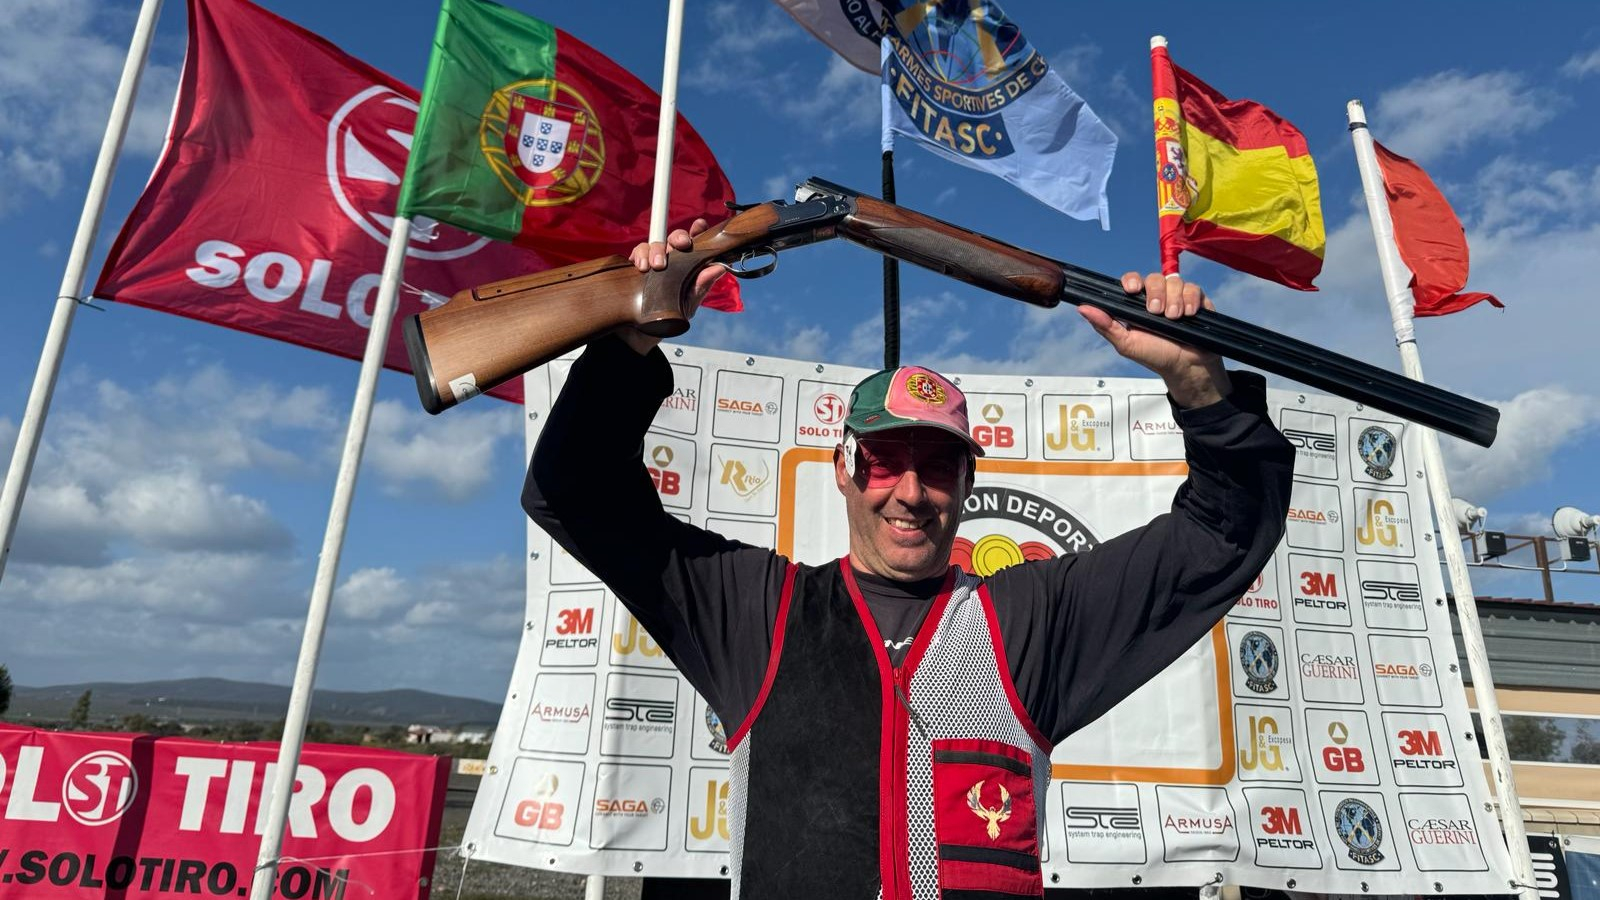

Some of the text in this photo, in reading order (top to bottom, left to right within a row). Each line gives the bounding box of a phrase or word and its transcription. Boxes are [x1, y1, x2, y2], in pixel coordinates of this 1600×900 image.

[890, 37, 932, 92] ARMES
[934, 85, 1005, 112] SPORTIVES
[1005, 72, 1031, 97] DE
[896, 73, 997, 155] FITASC
[186, 241, 399, 329] SOLO
[672, 388, 696, 399] AR
[662, 397, 696, 411] RINI
[717, 398, 763, 413] SAGA
[799, 426, 842, 438] SOLO TI
[1132, 420, 1177, 434] ARMU
[972, 425, 1014, 448] GB
[1288, 508, 1326, 521] SAGA
[962, 492, 1093, 553] ON DEPOR
[1300, 572, 1337, 598] 3M
[1255, 597, 1278, 609] TIRO
[1294, 598, 1347, 610] PELTOR
[556, 608, 594, 635] 3M
[545, 638, 598, 649] PELTOR
[1302, 665, 1359, 680] GUERINI
[1375, 664, 1418, 676] SAGA
[531, 702, 590, 722] ARMUSA
[713, 741, 730, 754] FIT
[1398, 730, 1443, 756] 3M
[1323, 747, 1365, 773] GB
[1393, 759, 1456, 769] PELTOR
[0, 745, 61, 822] L
[175, 756, 396, 842] TIRO
[596, 799, 648, 812] SAGA
[514, 800, 565, 830] GB
[1261, 806, 1302, 835] 3M
[1165, 815, 1233, 834] ARMUSA
[1408, 819, 1472, 831] CÆSAR
[1257, 839, 1314, 850] PELTOR
[1410, 830, 1477, 845] GUERINI
[1352, 852, 1380, 864] FITASC
[0, 849, 349, 900] .SOLOTIRO.OM
